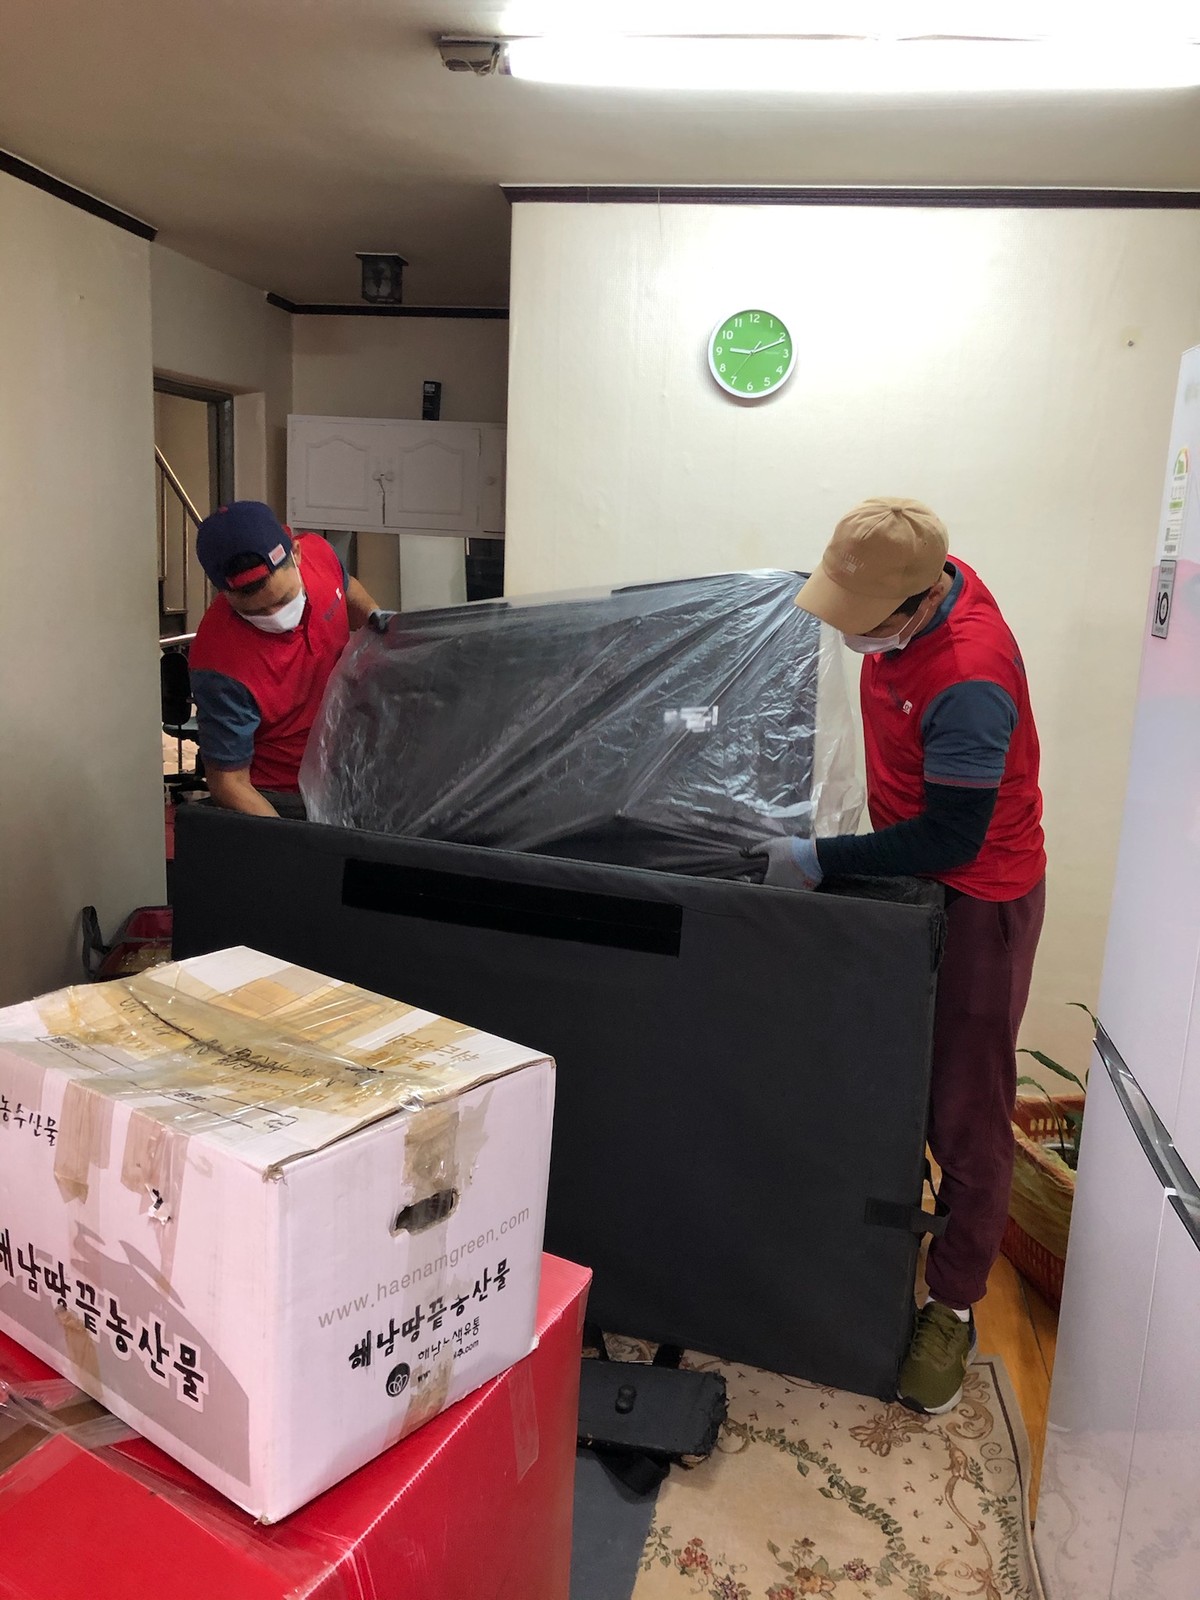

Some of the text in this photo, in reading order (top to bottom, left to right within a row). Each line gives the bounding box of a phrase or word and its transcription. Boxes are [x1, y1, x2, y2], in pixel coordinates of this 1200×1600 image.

[734, 318, 743, 328] 11
[749, 314, 761, 323] 12
[769, 319, 774, 329] 1
[722, 330, 734, 340] 10
[778, 332, 786, 342] 2
[716, 346, 723, 356] 9
[782, 349, 789, 359] 3
[719, 363, 726, 373] 8
[776, 365, 783, 375] 4
[730, 375, 737, 386] 7
[764, 377, 771, 387] 5
[746, 381, 754, 391] 6
[317, 1207, 530, 1329] www.haenamgreen.com
